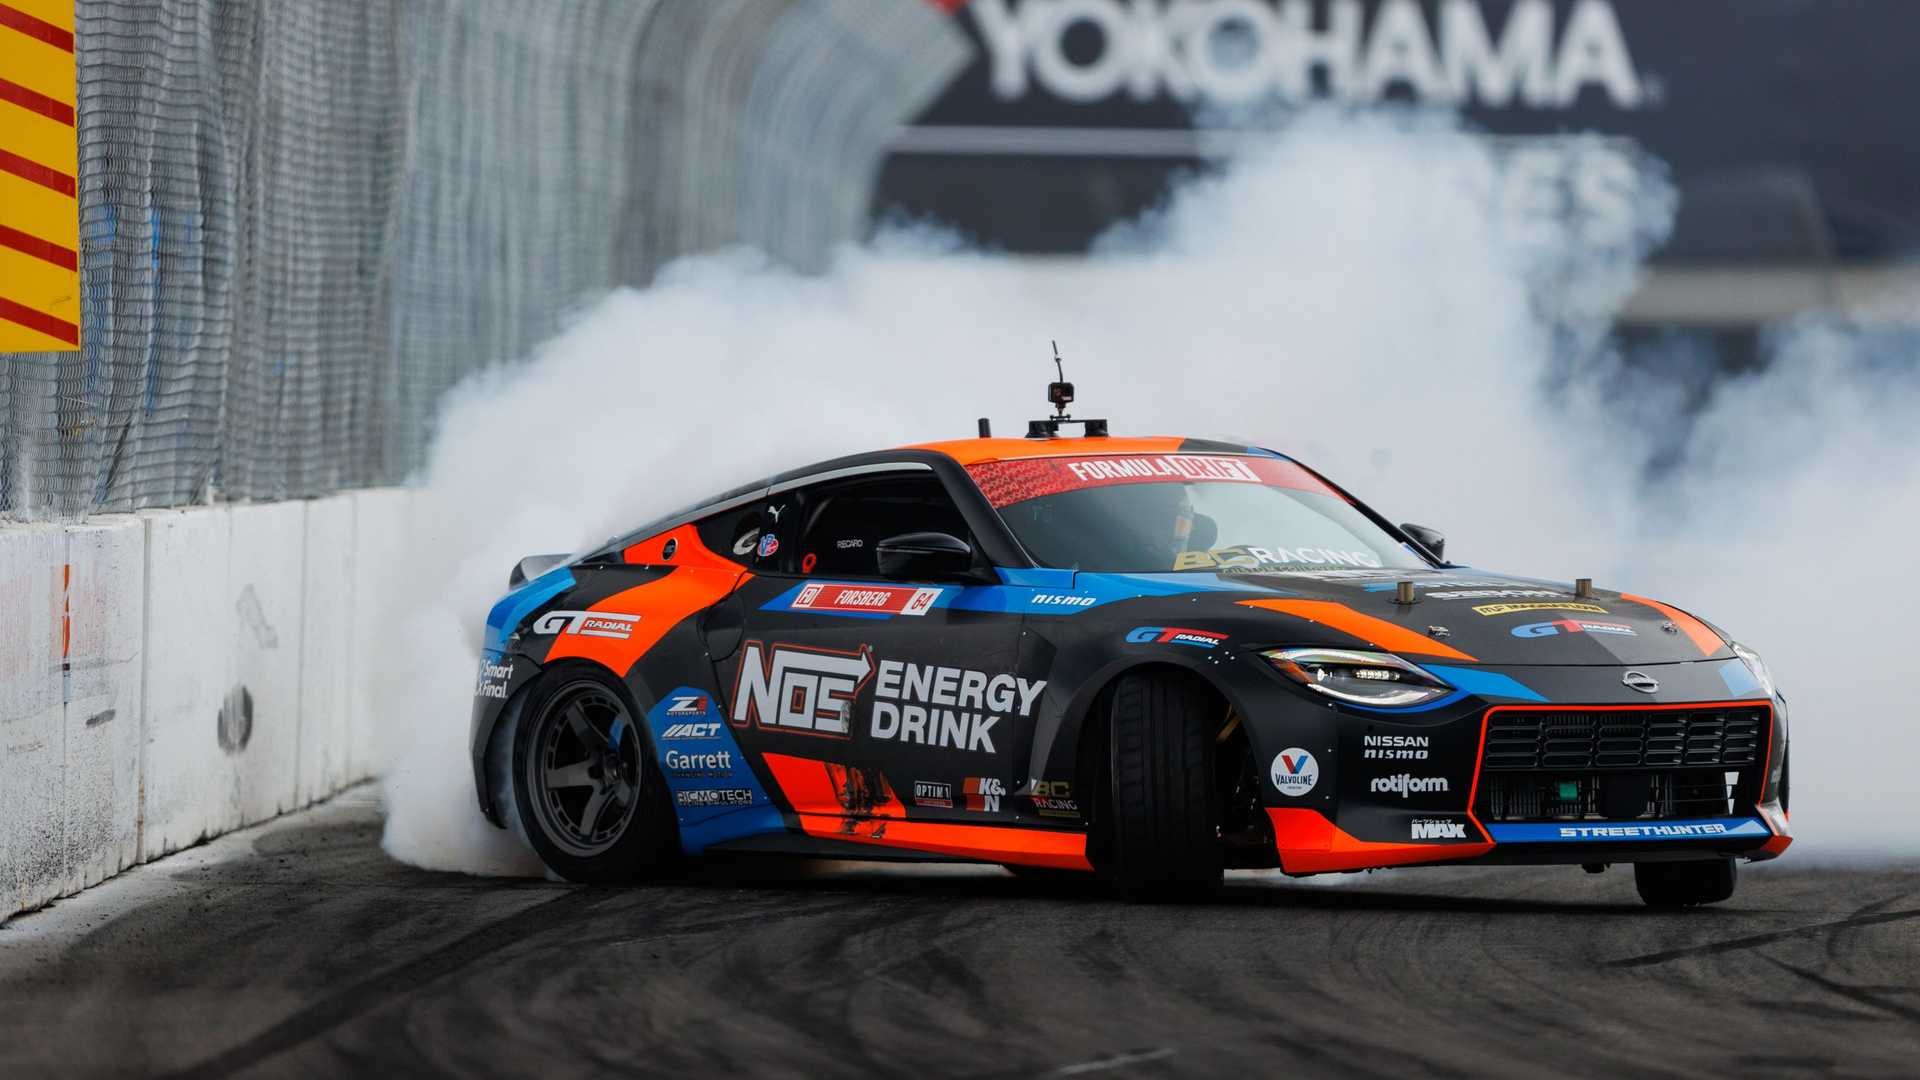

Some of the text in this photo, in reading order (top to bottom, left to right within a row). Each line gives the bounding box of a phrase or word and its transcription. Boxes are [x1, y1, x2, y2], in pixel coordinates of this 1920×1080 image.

[968, 0, 1642, 106] YOKOHAMA
[1067, 456, 1261, 482] FORMULA DRIFT
[837, 539, 863, 549] RECARO
[1172, 545, 1260, 571] BC
[1247, 547, 1384, 569] RACING
[834, 590, 892, 607] FORSBERG
[911, 592, 934, 610] 64
[1031, 593, 1097, 606] nismo
[584, 620, 632, 631] RADIAL
[1175, 634, 1220, 645] RADIAL
[485, 660, 513, 680] Smart
[733, 646, 1047, 734] NOS ENERGY
[870, 701, 1000, 754] DRINK
[1364, 736, 1428, 747] NISSAN
[666, 750, 731, 769] Garrett
[1364, 749, 1428, 759] nismo
[1275, 773, 1312, 786] VALVOLINE
[1370, 773, 1448, 798] rotiform
[984, 796, 1000, 812] N
[1034, 799, 1078, 810] RACING
[1411, 823, 1467, 839] MAX
[1560, 824, 1727, 837] STREETHUNTER
